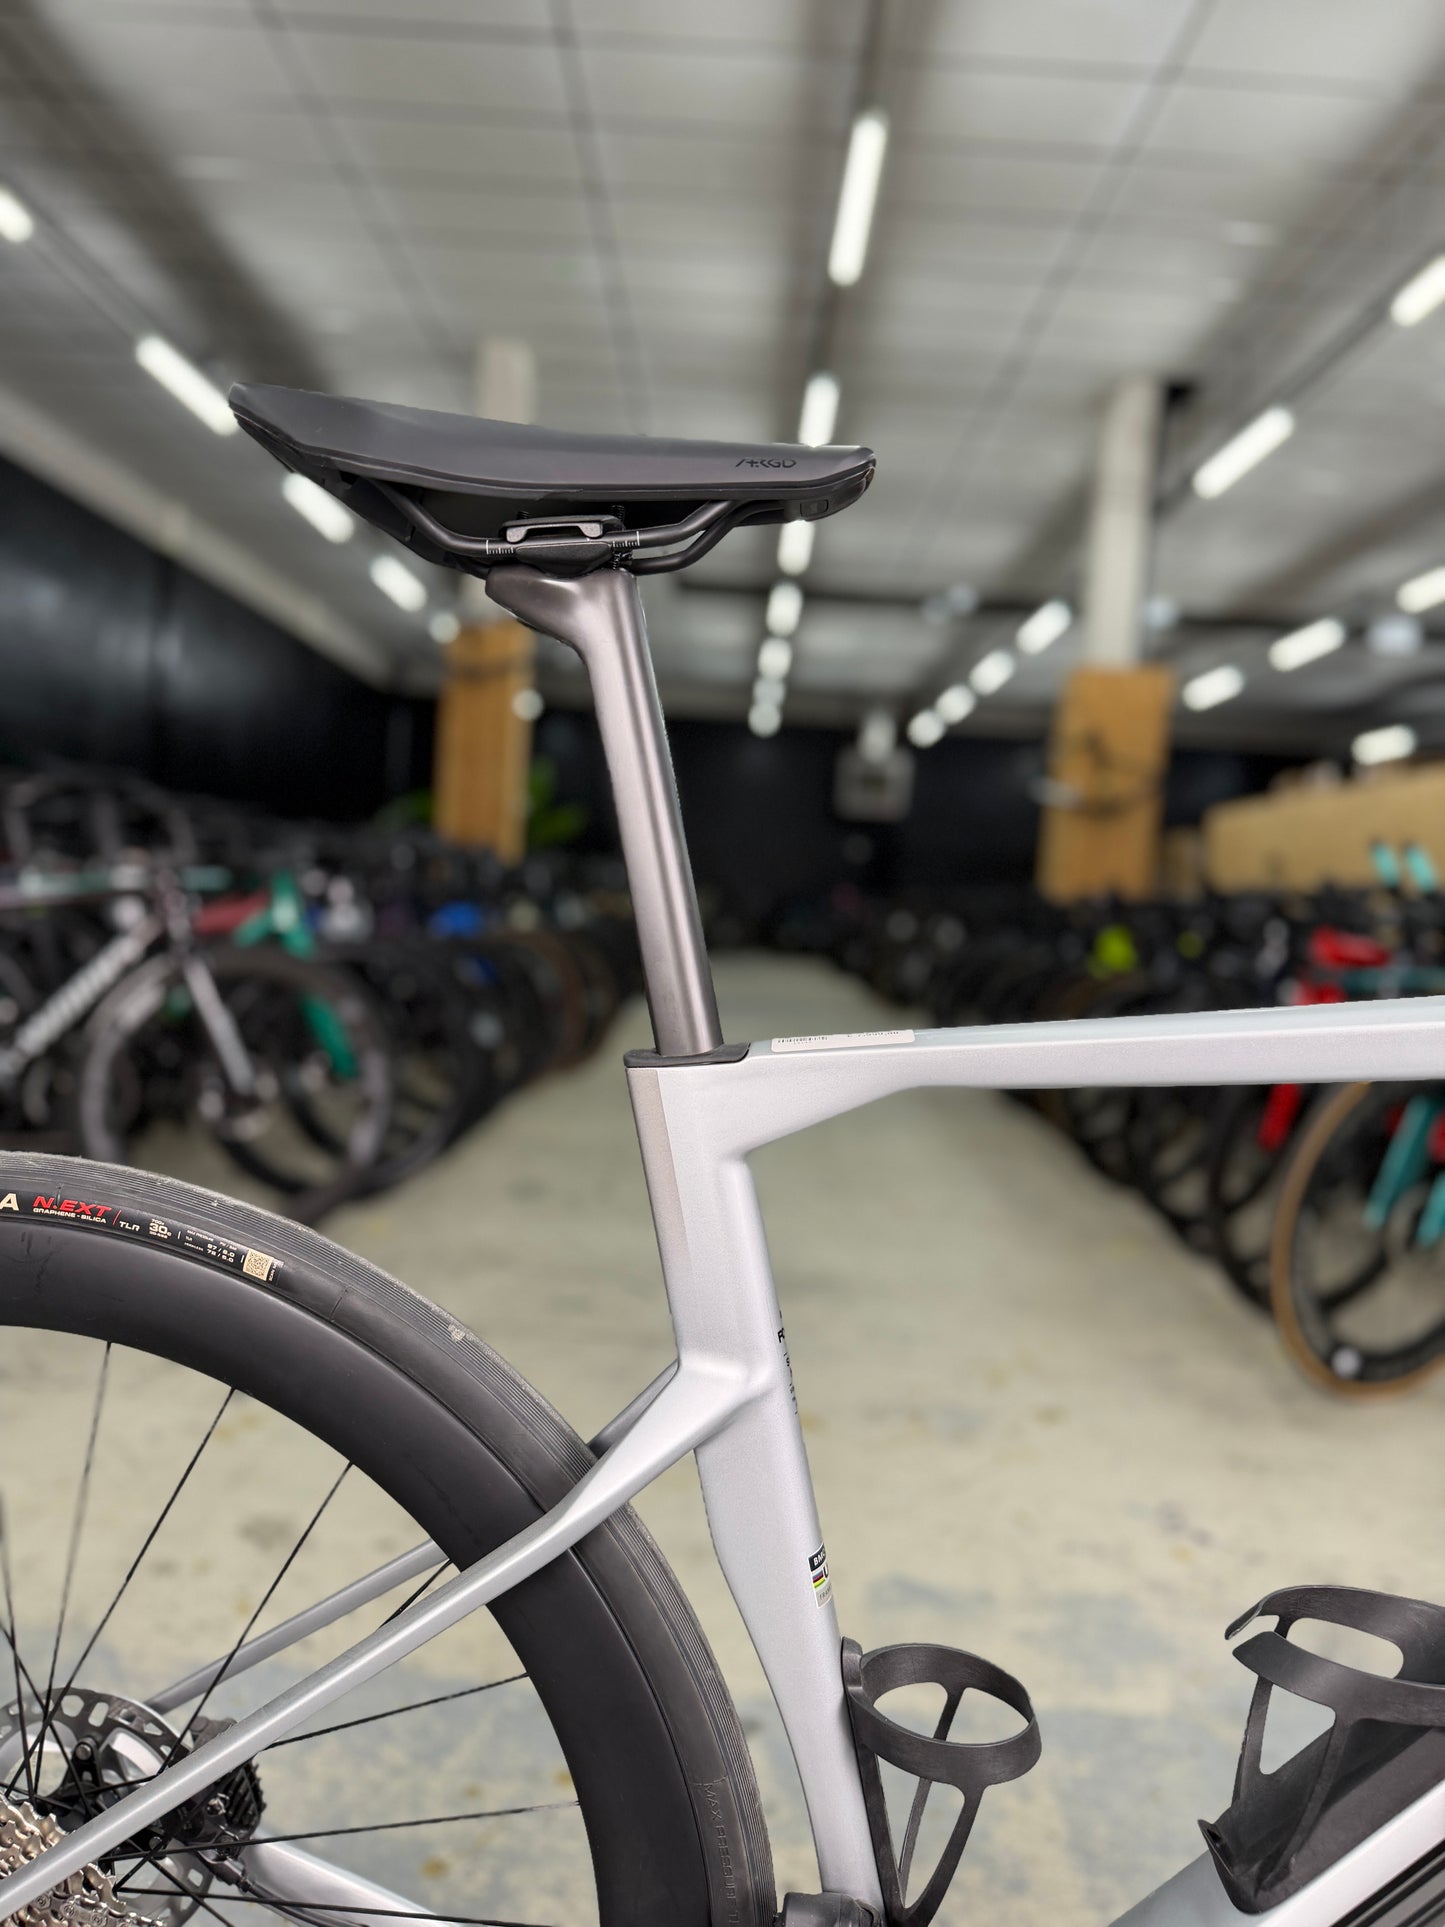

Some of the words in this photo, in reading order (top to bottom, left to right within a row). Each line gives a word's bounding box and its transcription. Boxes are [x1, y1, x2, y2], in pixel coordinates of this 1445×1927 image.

[33, 1195, 112, 1217] N.EXT
[33, 1207, 76, 1218] GRAPHENE
[81, 1214, 107, 1224] SILICA
[119, 1220, 140, 1231] TLR
